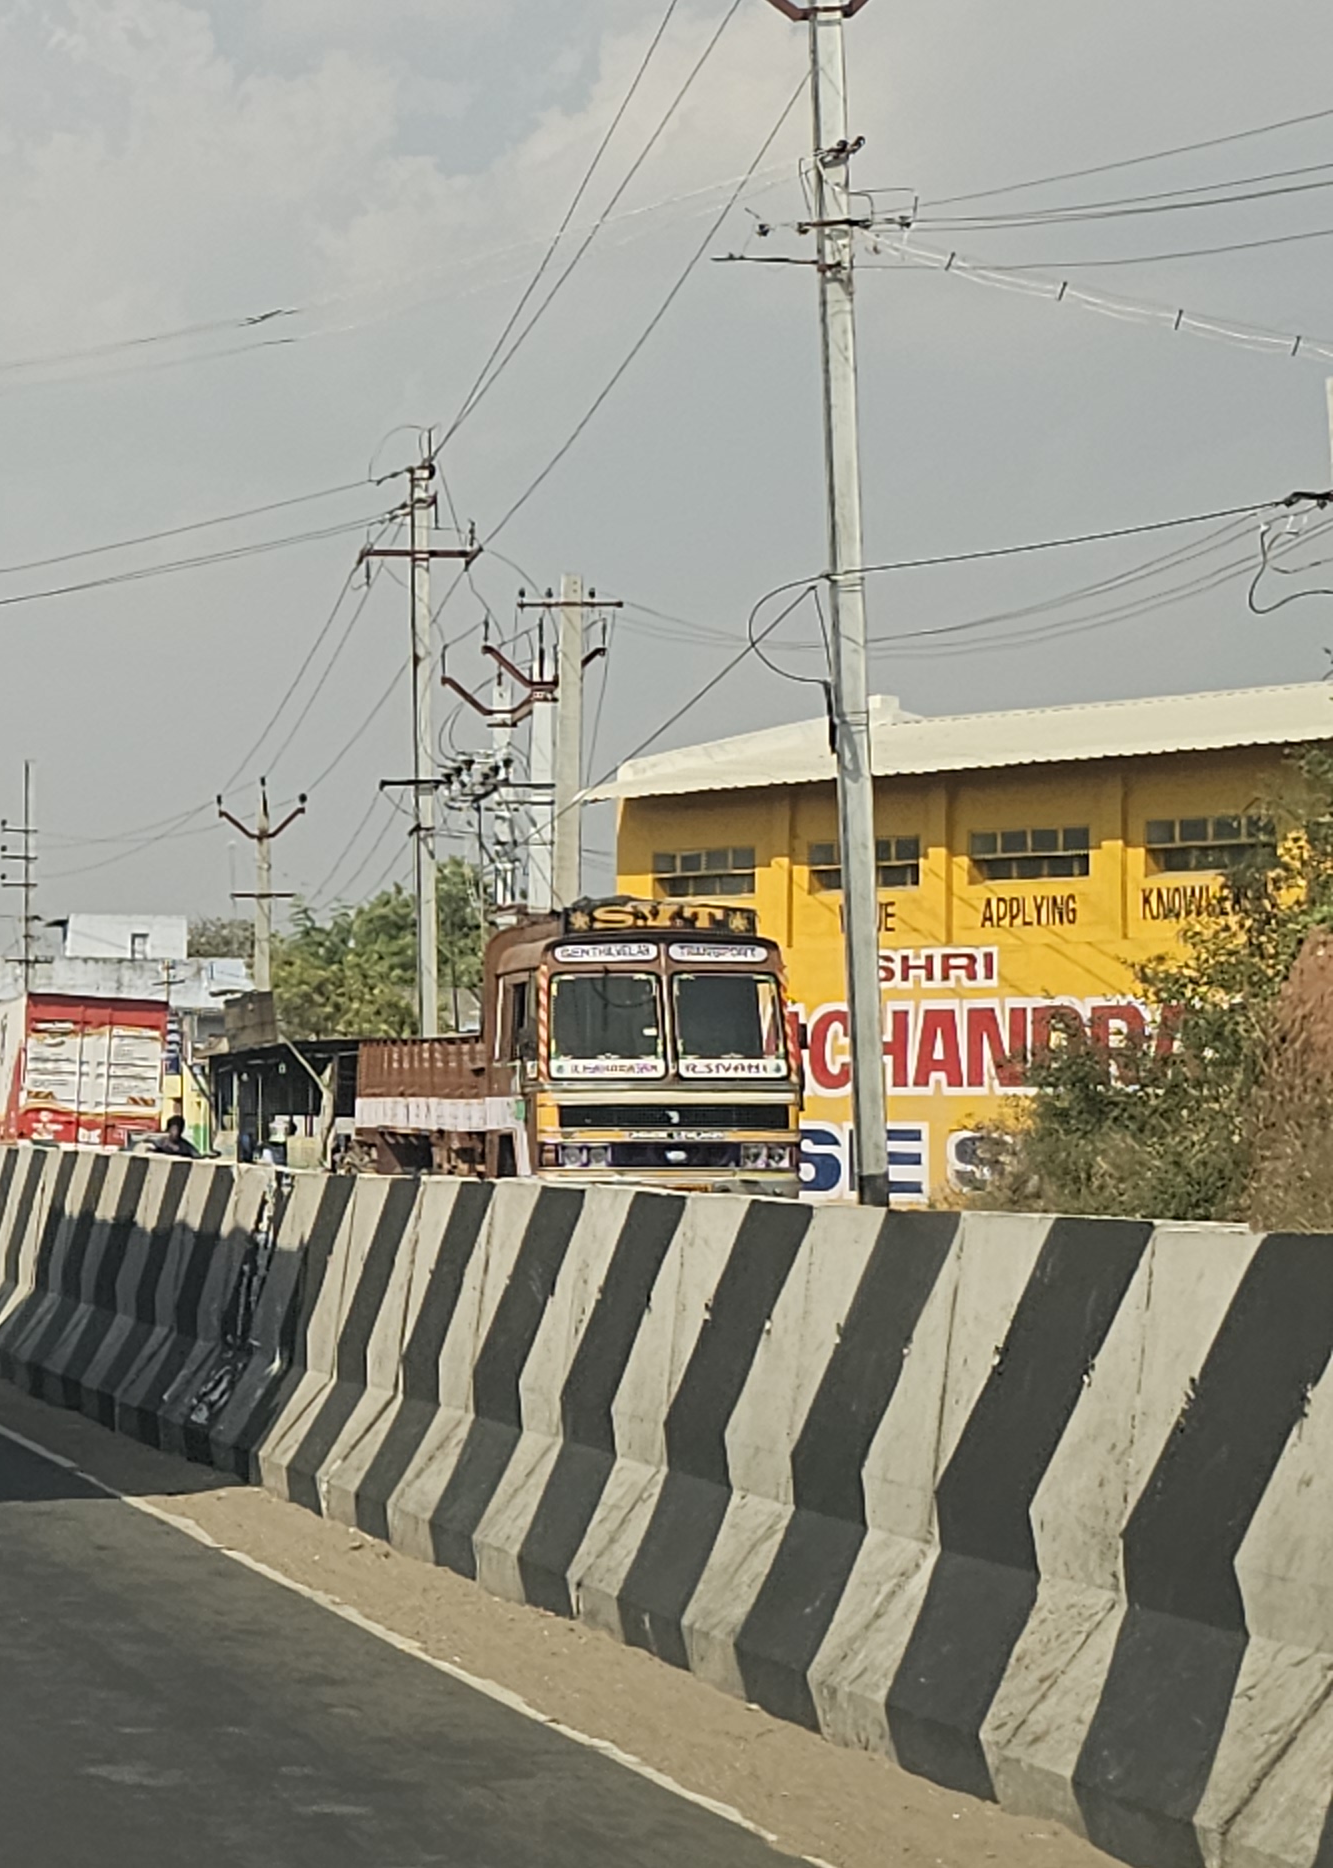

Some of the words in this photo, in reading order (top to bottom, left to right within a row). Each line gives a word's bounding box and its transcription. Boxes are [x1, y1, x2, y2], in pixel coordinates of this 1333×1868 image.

[980, 893, 1078, 927] APPLYING
[878, 951, 994, 982] SHRI
[788, 1004, 1205, 1089] CHANDRA
[800, 1128, 922, 1193] SE
